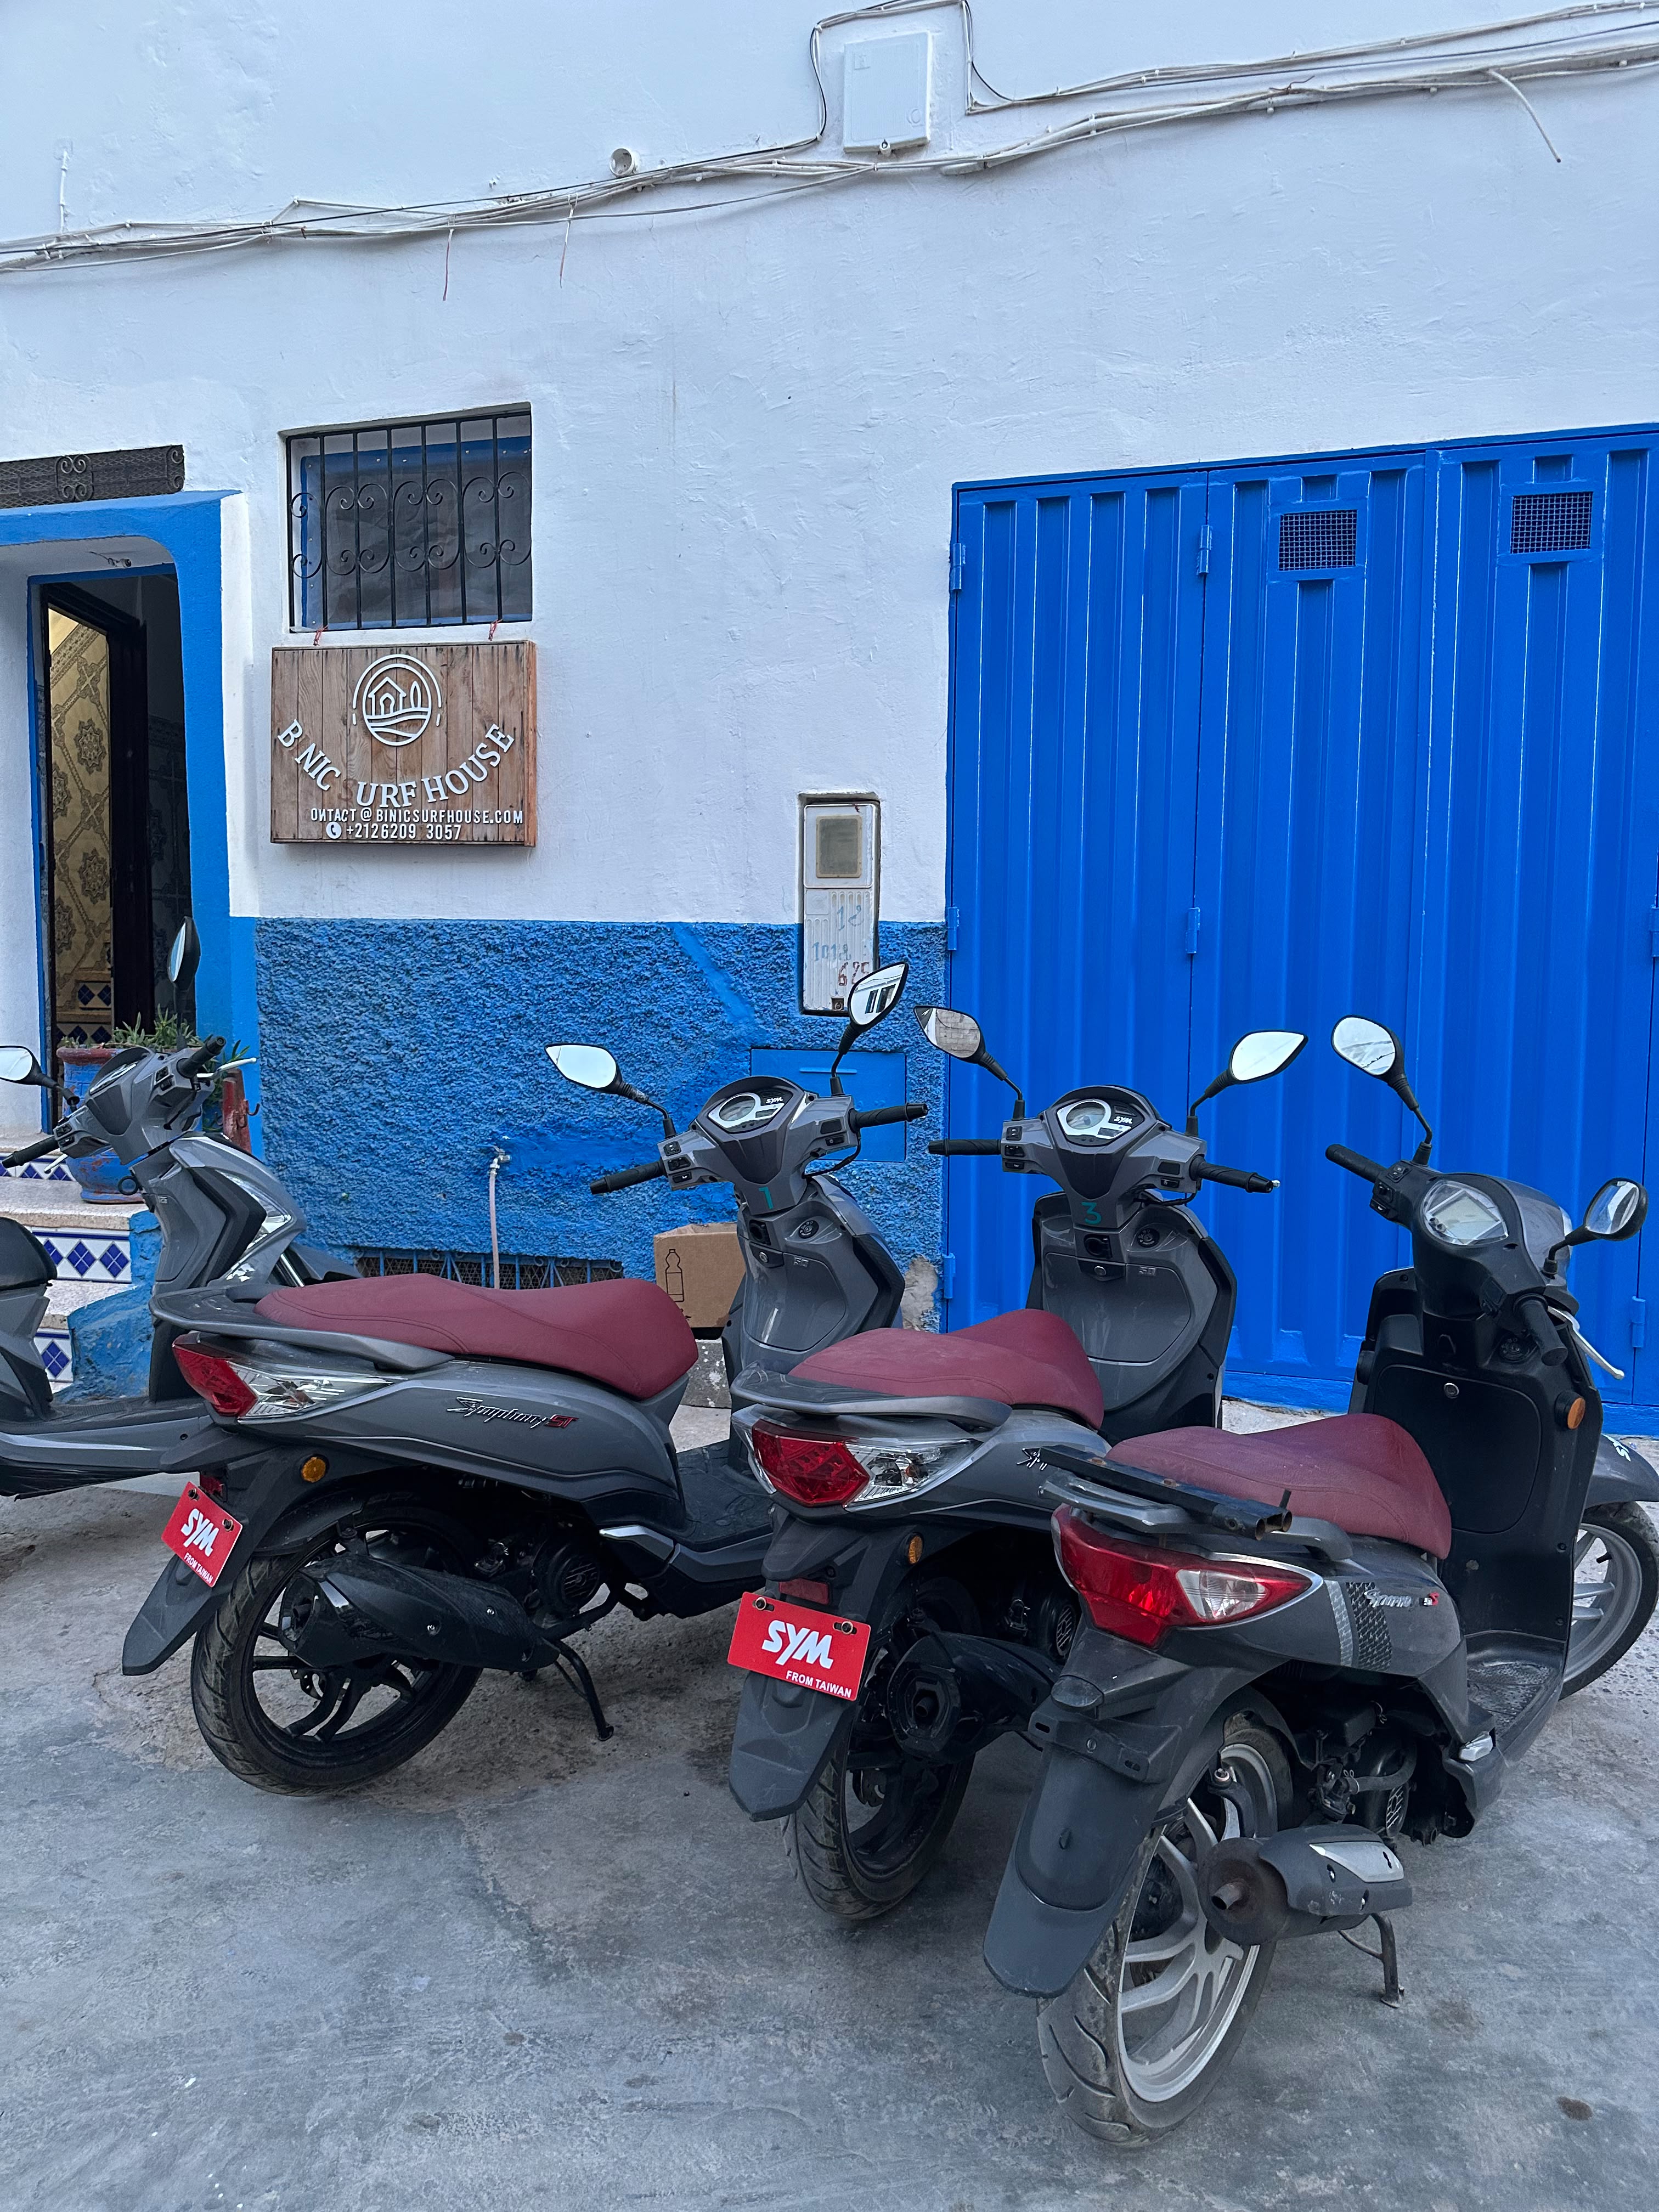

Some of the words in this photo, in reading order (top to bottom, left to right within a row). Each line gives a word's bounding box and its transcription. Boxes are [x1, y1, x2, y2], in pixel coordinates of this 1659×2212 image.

[421, 724, 515, 803] HOUSE
[1114, 1116, 1133, 1124] SYM
[759, 1186, 773, 1210] 1
[1081, 1201, 1102, 1225] 3
[180, 1508, 220, 1558] SYM
[184, 1552, 198, 1570] FROM
[196, 1562, 214, 1584] TAIWAN
[761, 1620, 834, 1669] SYM
[786, 1670, 814, 1686] FROM
[815, 1679, 851, 1698] TAIWAN
